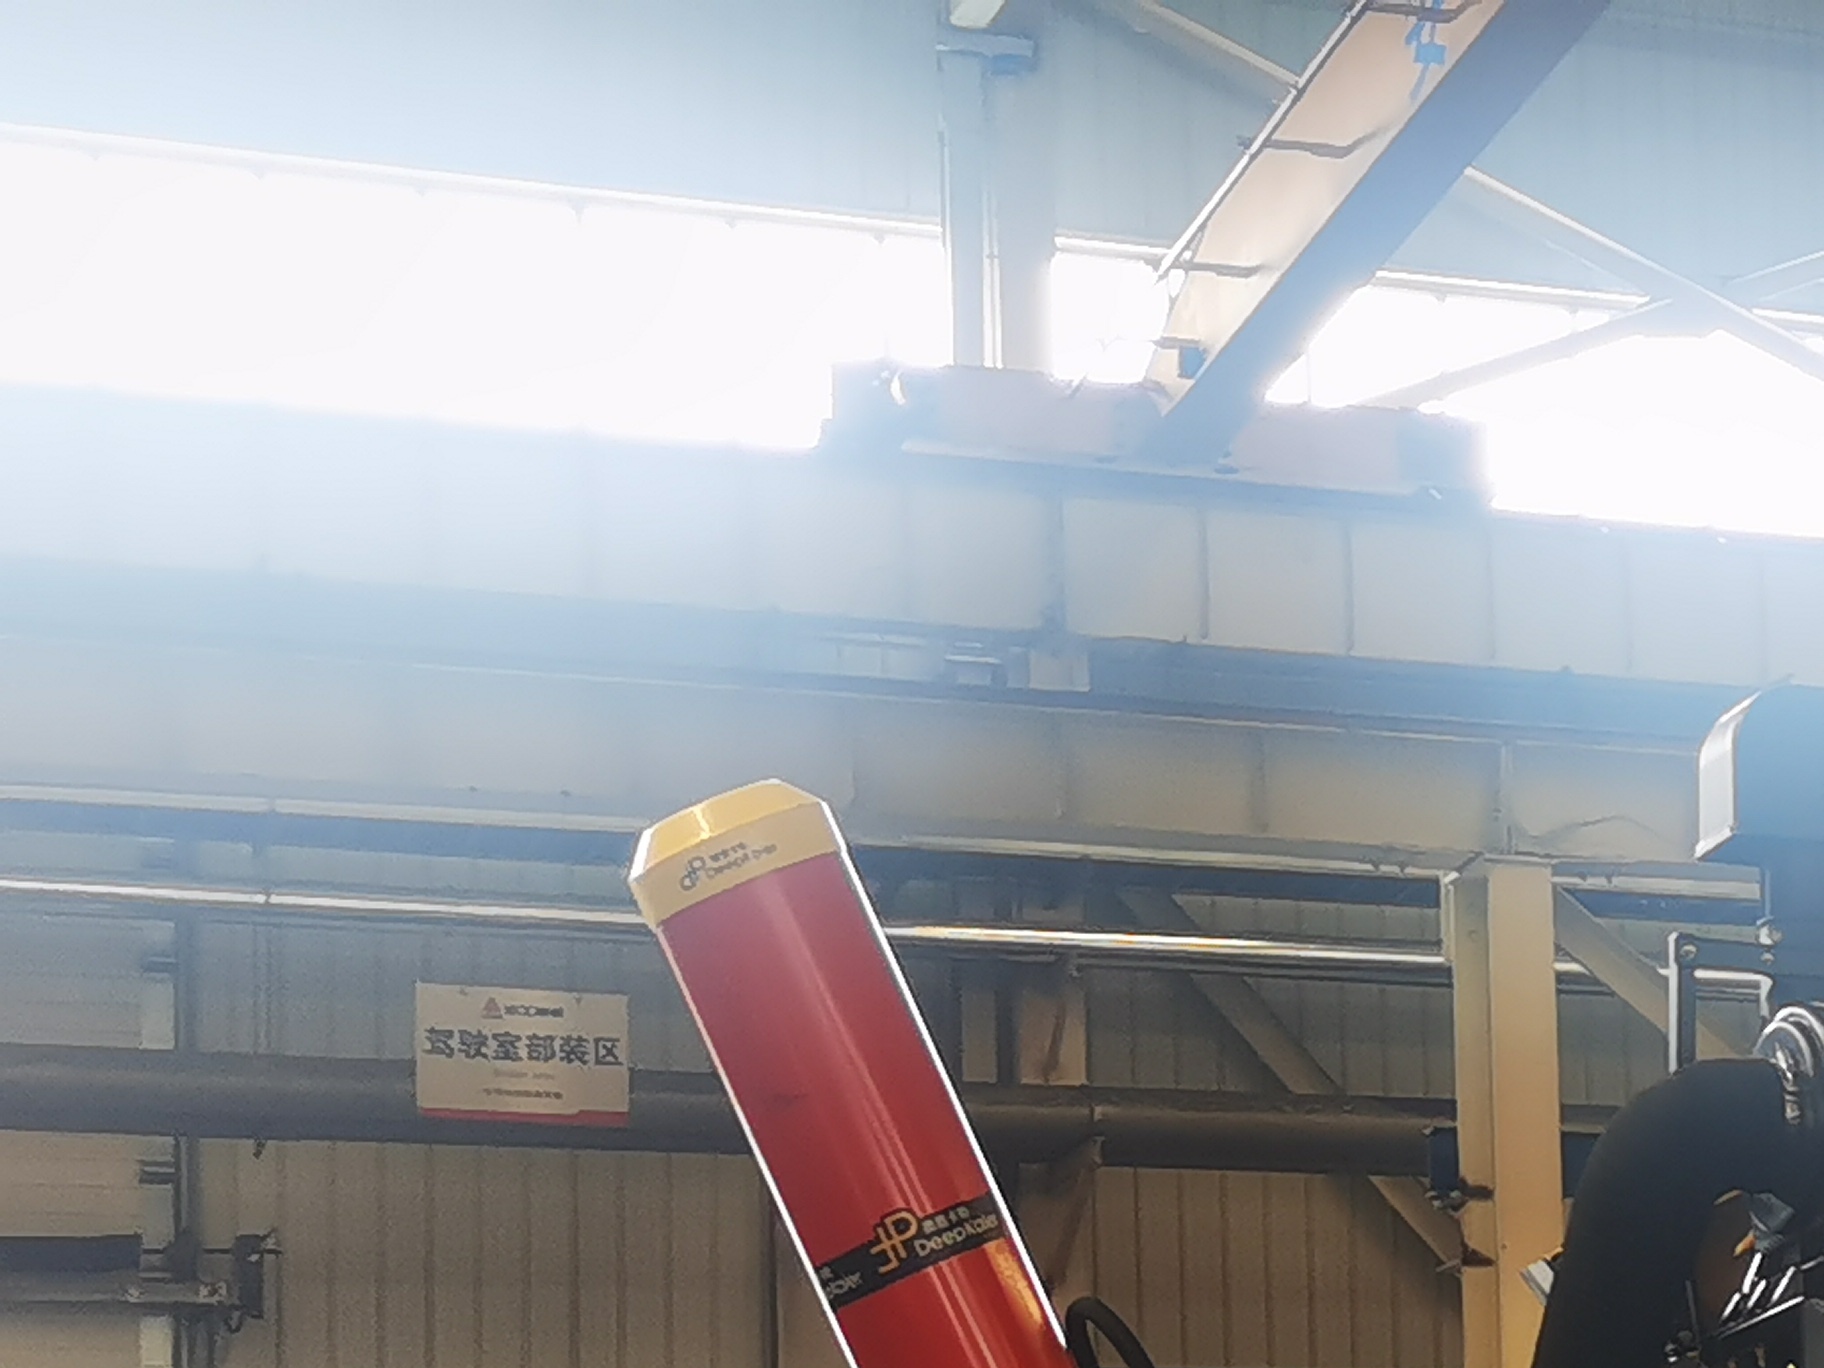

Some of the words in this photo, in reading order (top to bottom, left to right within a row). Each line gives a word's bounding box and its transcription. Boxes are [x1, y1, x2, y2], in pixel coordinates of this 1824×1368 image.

[422, 1026, 624, 1067] 驾驶室部装区
